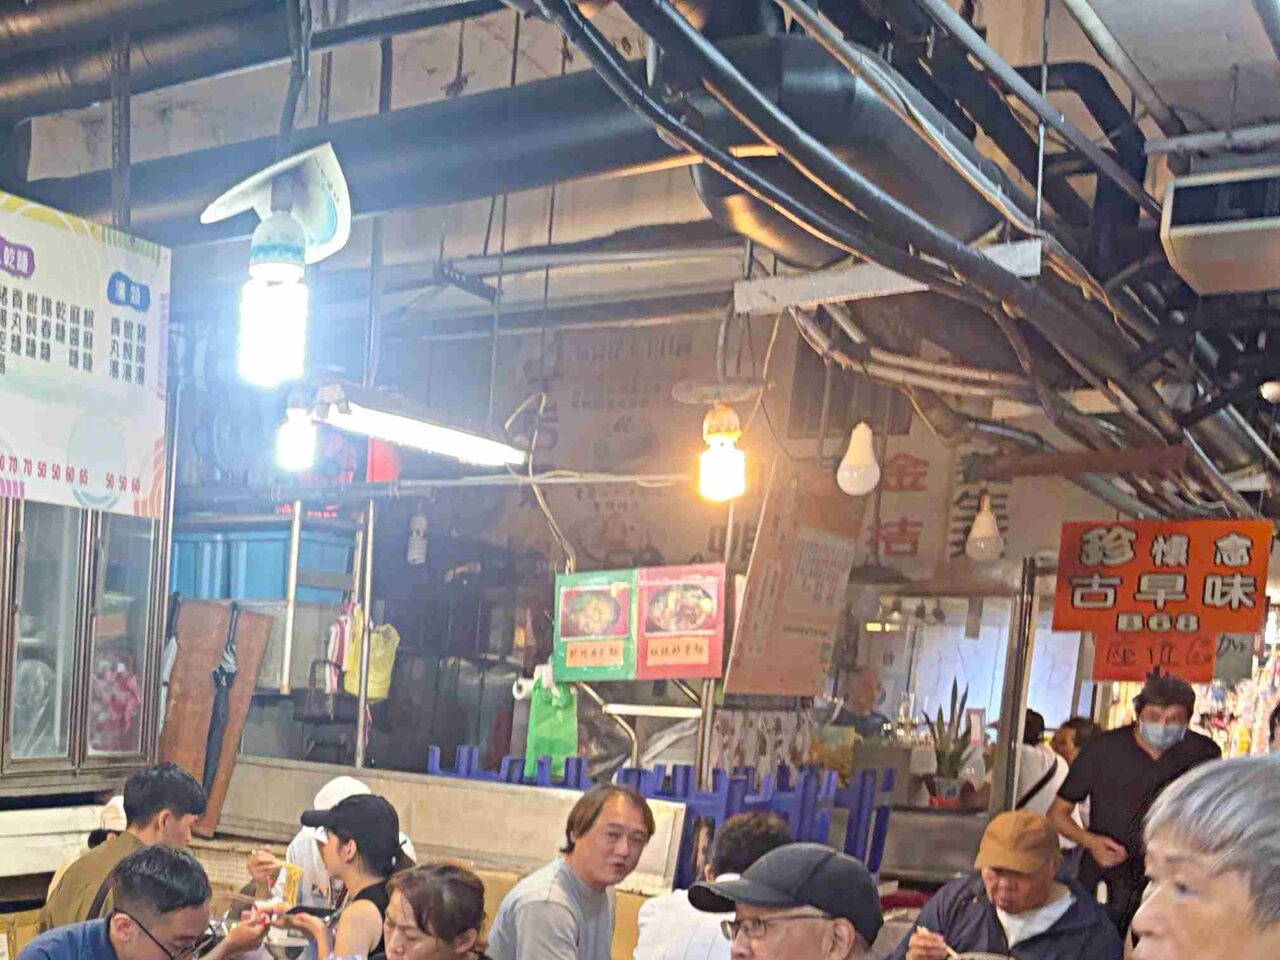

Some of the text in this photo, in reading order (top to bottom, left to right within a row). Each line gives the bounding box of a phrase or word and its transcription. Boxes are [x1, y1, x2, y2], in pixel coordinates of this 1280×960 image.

[8, 456, 18, 474] 70
[23, 459, 32, 476] 70
[37, 461, 47, 478] 50
[51, 463, 61, 481] 50
[65, 466, 75, 483] 60
[79, 468, 88, 486] 65
[1070, 572, 1256, 611] 古早味
